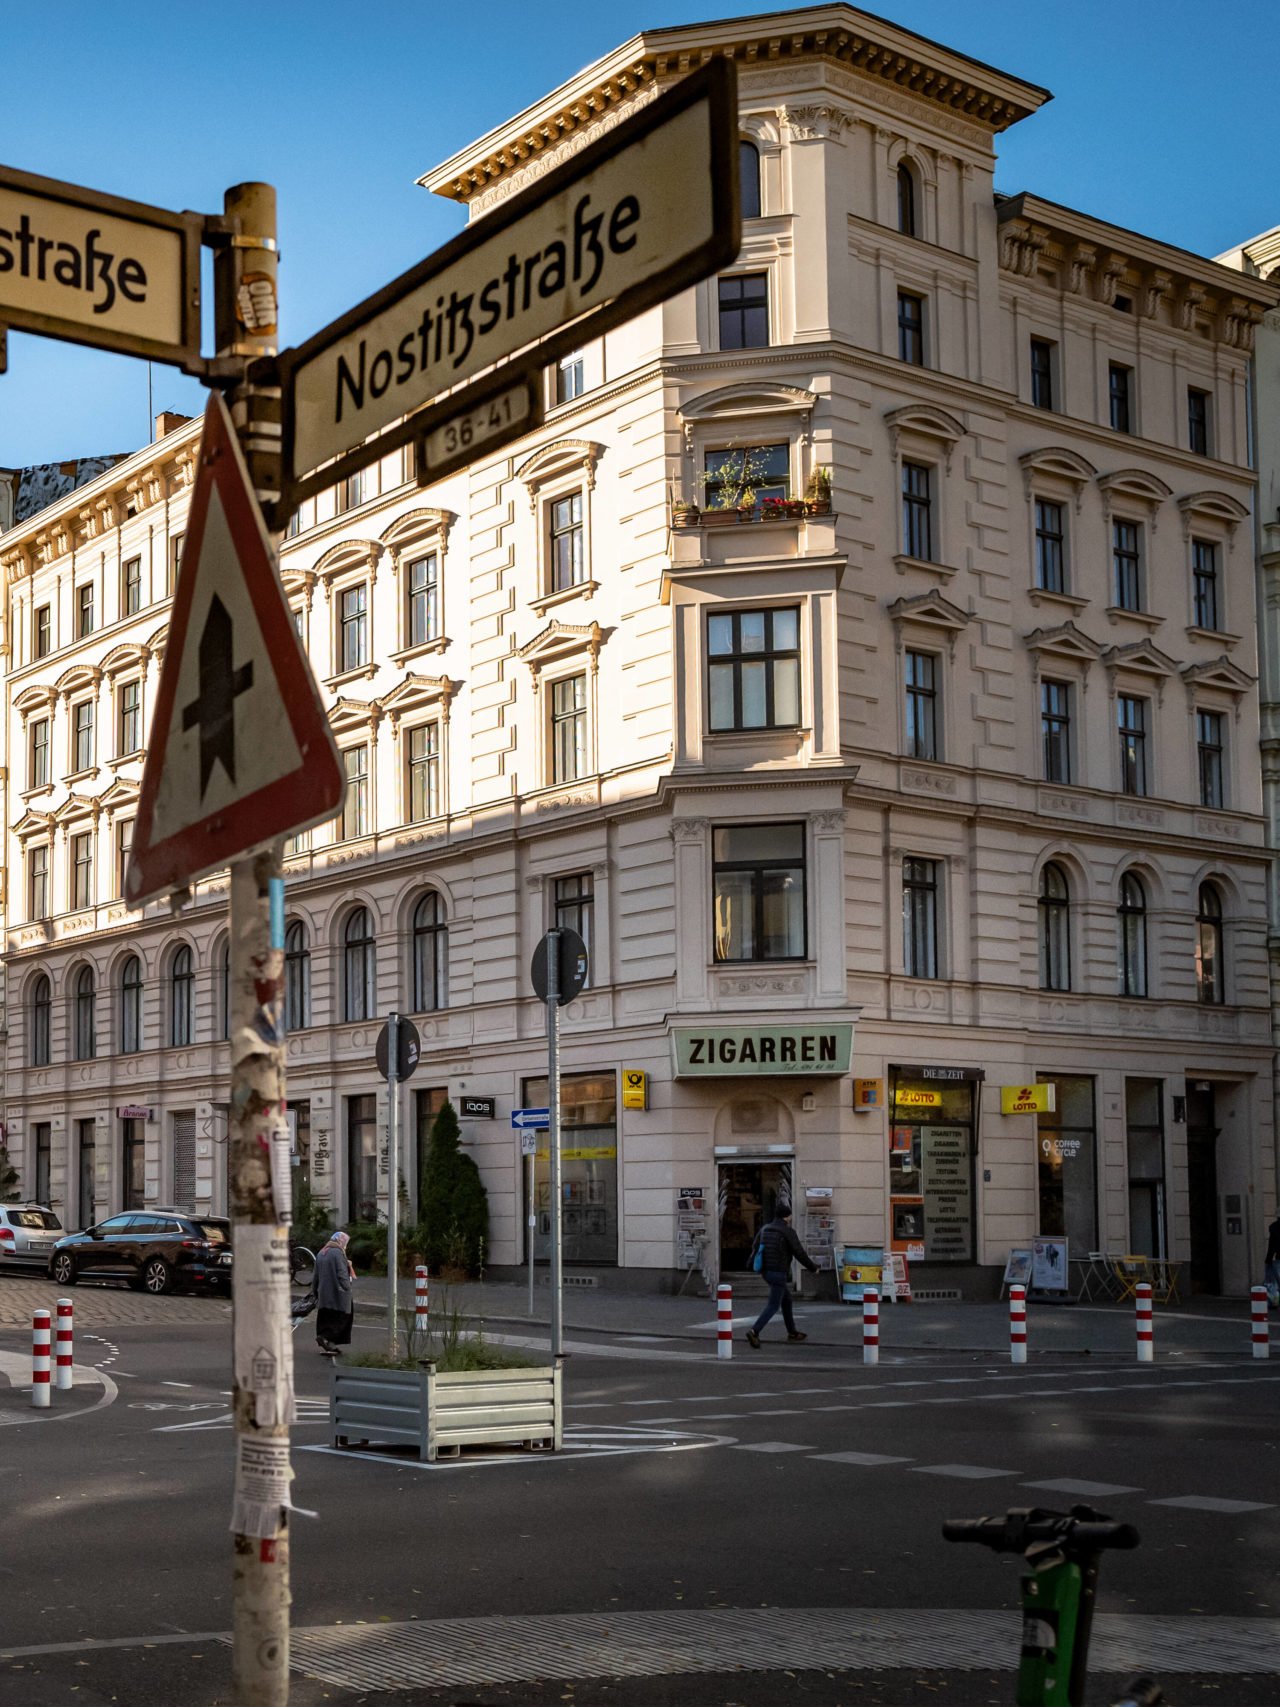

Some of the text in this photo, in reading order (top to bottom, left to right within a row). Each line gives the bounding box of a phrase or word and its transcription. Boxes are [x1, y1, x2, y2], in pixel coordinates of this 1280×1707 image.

[334, 193, 641, 424] Nostitzstraße
[689, 1035, 837, 1064] ZIGARREN
[923, 1069, 965, 1080] DIE ZEIT
[910, 1093, 935, 1103] LOTTO
[466, 1102, 490, 1112] IQOS
[1013, 1102, 1037, 1111] LOTTO
